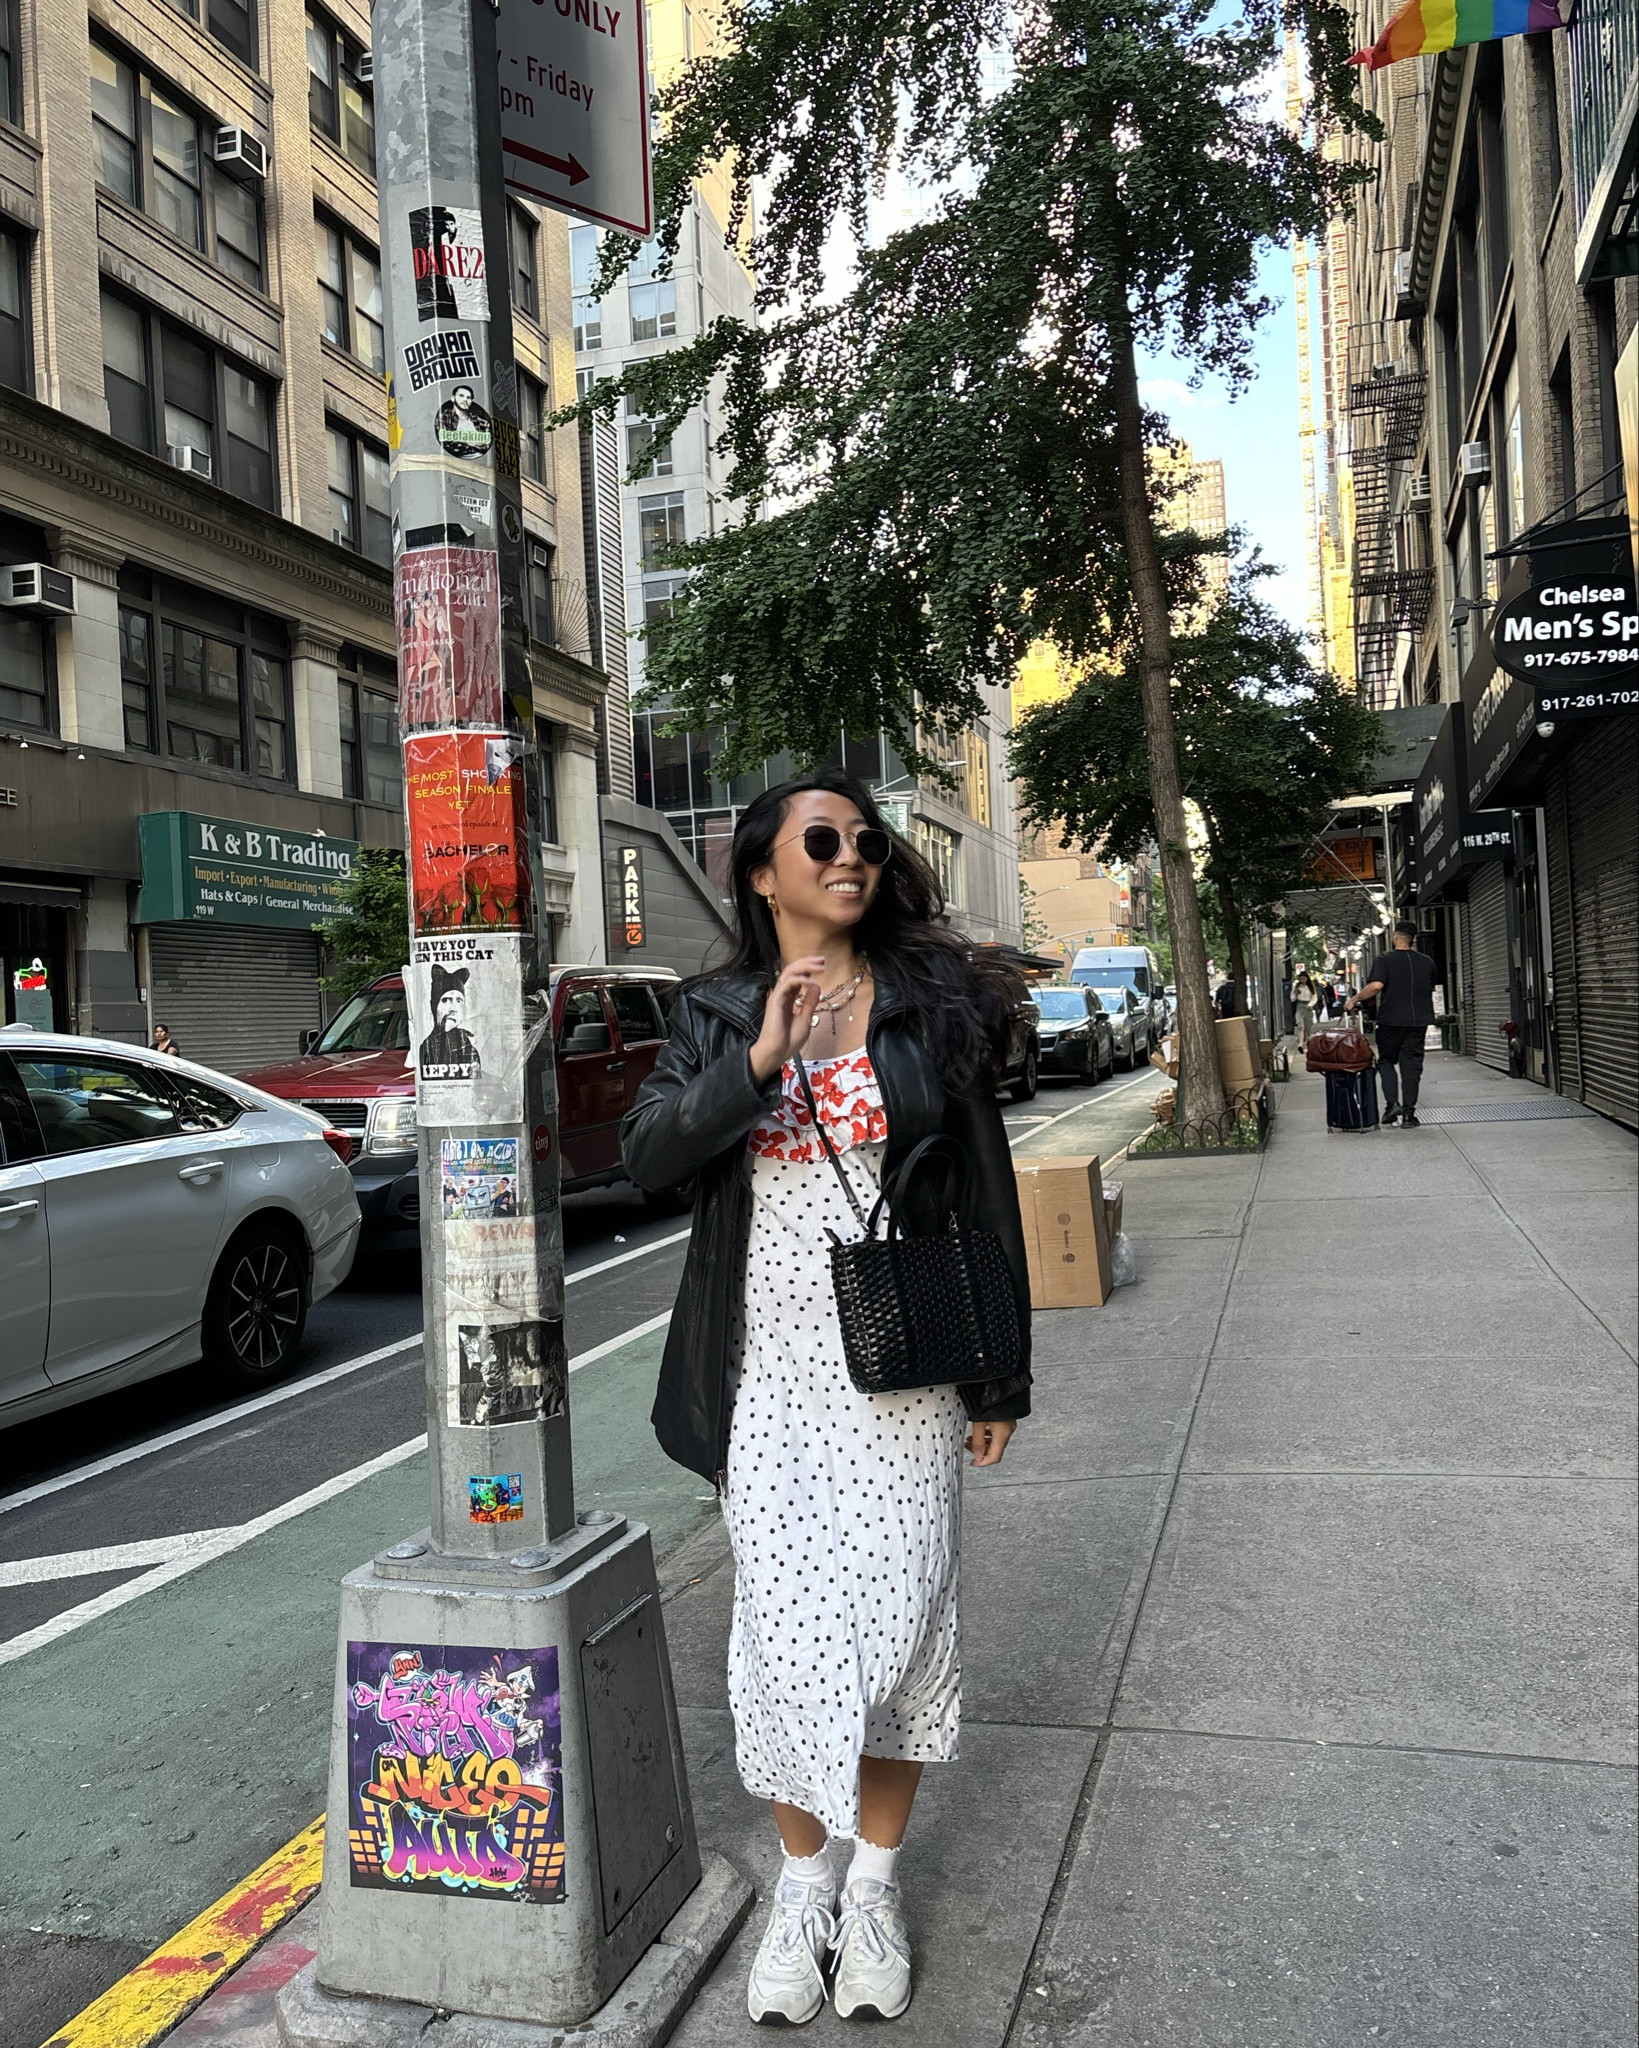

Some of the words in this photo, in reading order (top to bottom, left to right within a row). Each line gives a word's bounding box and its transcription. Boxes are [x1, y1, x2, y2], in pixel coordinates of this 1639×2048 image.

[555, 0, 621, 38] ONLY
[527, 55, 594, 112] Friday
[500, 85, 534, 118] pm
[410, 352, 480, 392] BROWN
[1539, 585, 1625, 606] Chelsea
[1504, 612, 1594, 642] Men's
[1601, 610, 1639, 641] Sp
[1524, 648, 1639, 667] 917-675-7984
[423, 769, 454, 781] MOST
[461, 768, 522, 781] SHOKING
[415, 786, 461, 799] SEASON
[467, 785, 512, 795] FINALE
[448, 800, 476, 810] YET:
[200, 823, 219, 852] K
[225, 833, 240, 856] &
[245, 831, 261, 858] B
[265, 834, 351, 878] Trading
[427, 842, 509, 859] BACHELOR
[1463, 835, 1475, 848] 116
[195, 866, 225, 884] Import
[230, 871, 258, 889] Export
[263, 875, 318, 897] Manufacturing
[623, 848, 640, 915] PARK
[201, 888, 224, 901] Hats
[225, 890, 234, 902] &
[235, 891, 259, 907] Caps
[265, 895, 300, 910] General
[302, 899, 354, 915] Merchadise
[207, 905, 215, 915] W
[448, 939, 477, 950] YOU
[433, 951, 463, 962] THIS
[466, 950, 494, 960] CAT
[535, 1136, 549, 1151] tiny
